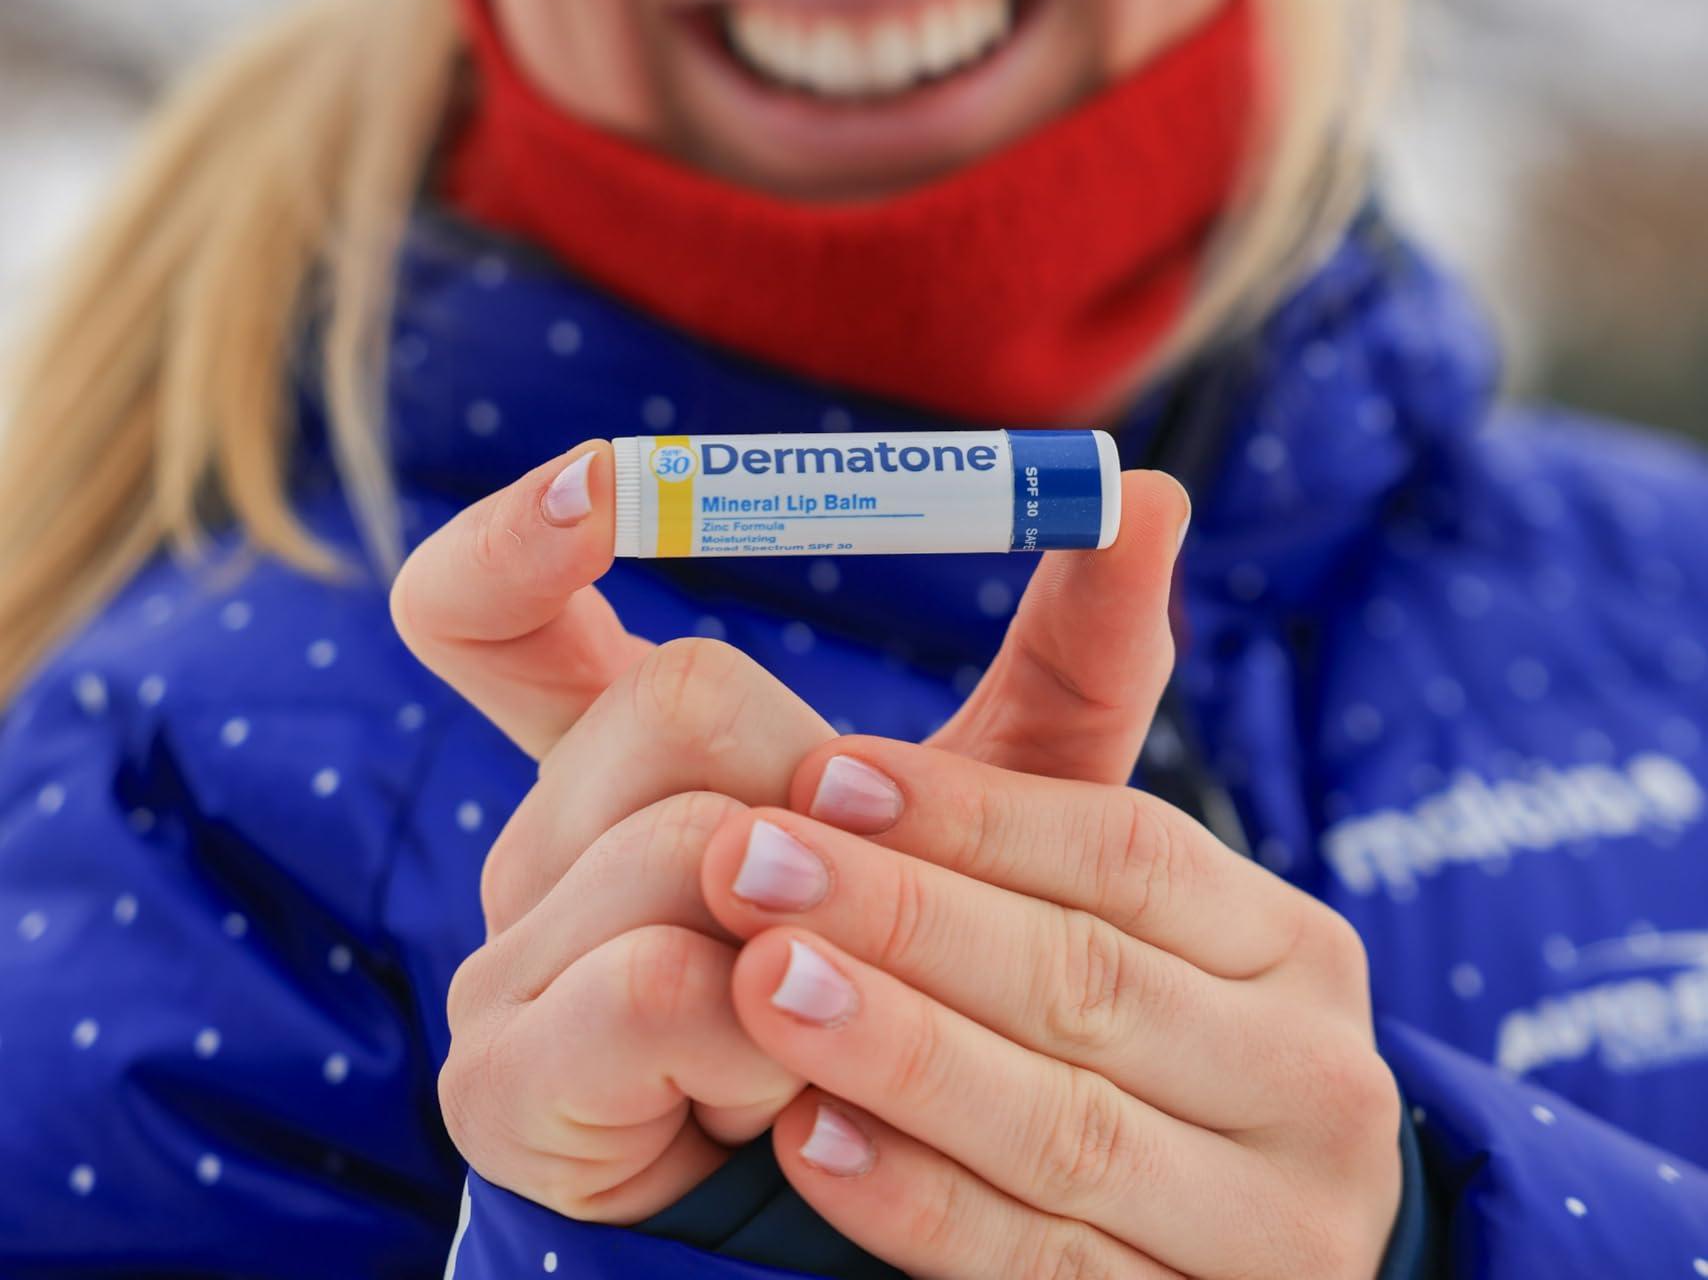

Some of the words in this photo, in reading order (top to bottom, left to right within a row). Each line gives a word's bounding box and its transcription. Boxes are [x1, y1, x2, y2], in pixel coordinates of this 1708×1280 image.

[656, 456, 689, 475] 30
[701, 442, 997, 475] Dermatone
[1025, 466, 1039, 497] SPF
[702, 495, 779, 513] Mineral
[787, 494, 817, 513] Lip
[825, 493, 877, 511] Balm
[1026, 500, 1039, 517] 30
[702, 522, 729, 532] Zinc
[733, 521, 785, 532] Formula
[702, 535, 776, 545] Moisturizing
[743, 544, 804, 552] Spectrum
